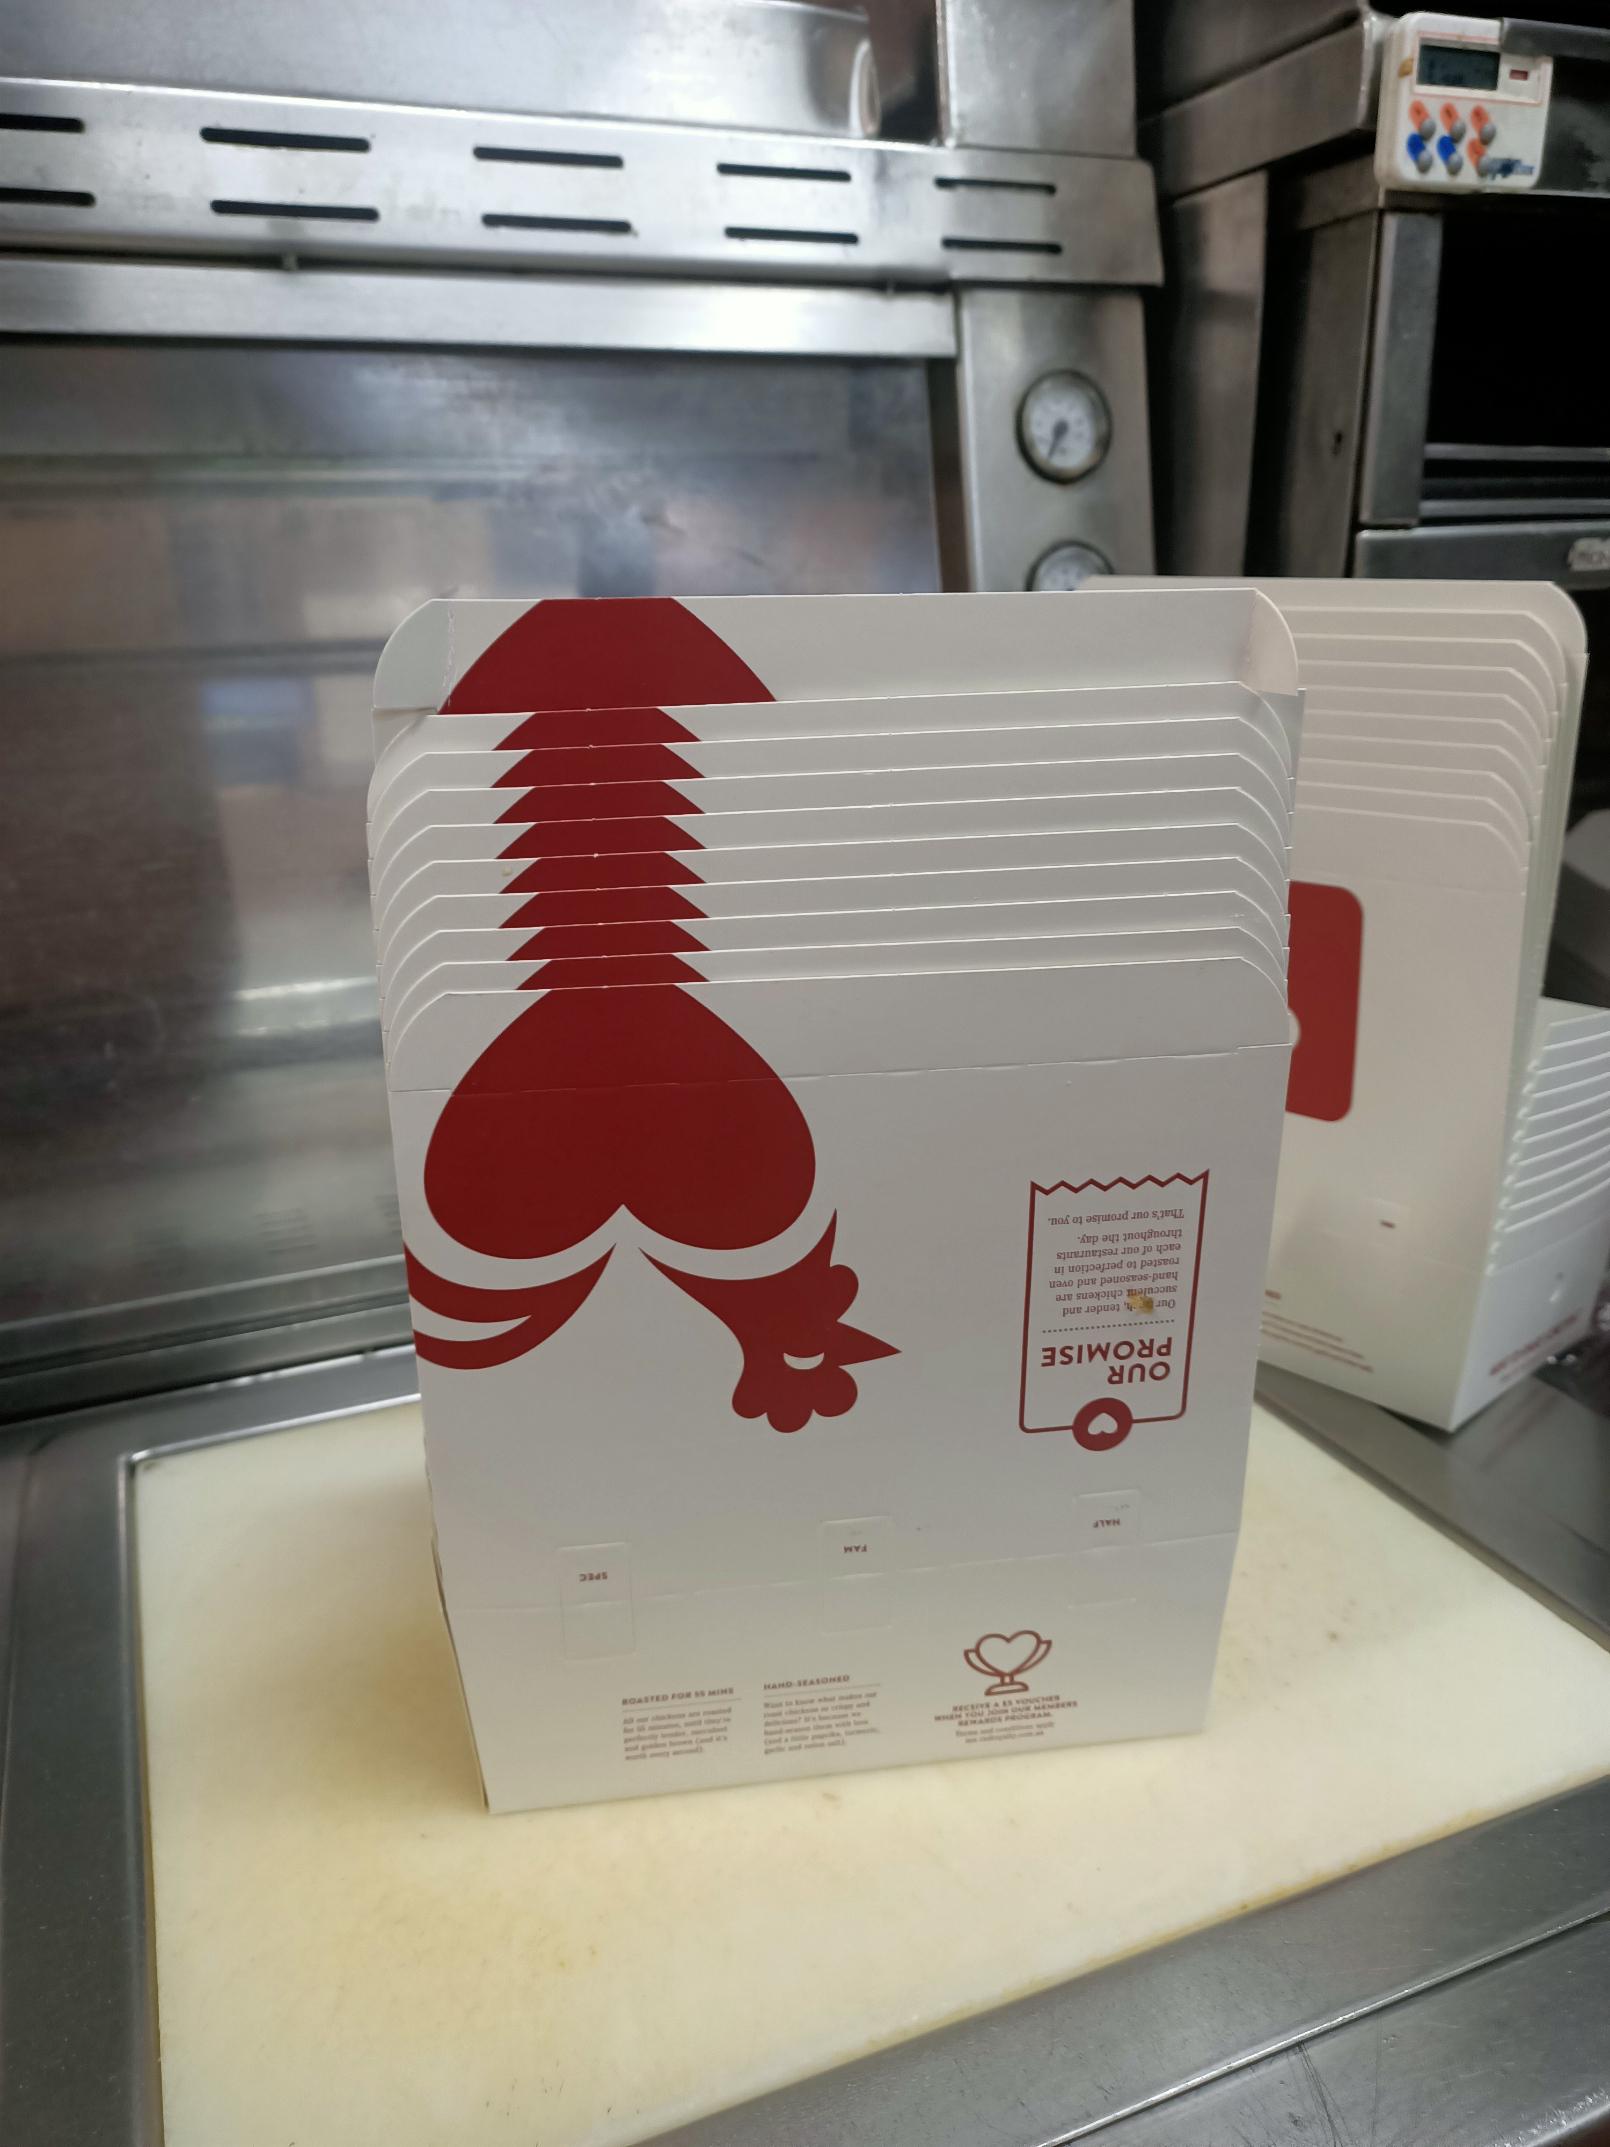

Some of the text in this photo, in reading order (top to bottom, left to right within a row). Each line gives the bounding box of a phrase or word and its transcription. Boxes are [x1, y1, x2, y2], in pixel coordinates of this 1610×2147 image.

[1048, 1208, 1184, 1228] That's our promise to you.
[1077, 1228, 1182, 1245] throughout the day.
[1056, 1243, 1181, 1261] each of our restaurants
[1054, 1257, 1179, 1275] roasted to perfection in
[1049, 1271, 1178, 1289] hand-seasoned and oven
[1056, 1294, 1072, 1302] are
[1076, 1290, 1123, 1301] chickens
[1086, 1303, 1120, 1314] tender
[1156, 1299, 1175, 1308] Our
[1062, 1307, 1082, 1317] and
[1041, 1337, 1172, 1367] PROMISE
[1107, 1362, 1171, 1385] OUR
[1093, 1519, 1120, 1528] HALF
[843, 1543, 868, 1555] FAM
[579, 1572, 608, 1582] SPEC
[764, 1675, 850, 1690] HAND-SEASONED
[622, 1694, 668, 1705] ROASTED
[952, 1702, 991, 1712] RECEIVE
[1016, 1695, 1060, 1704] VOUCHER
[935, 1713, 962, 1721] WHEN
